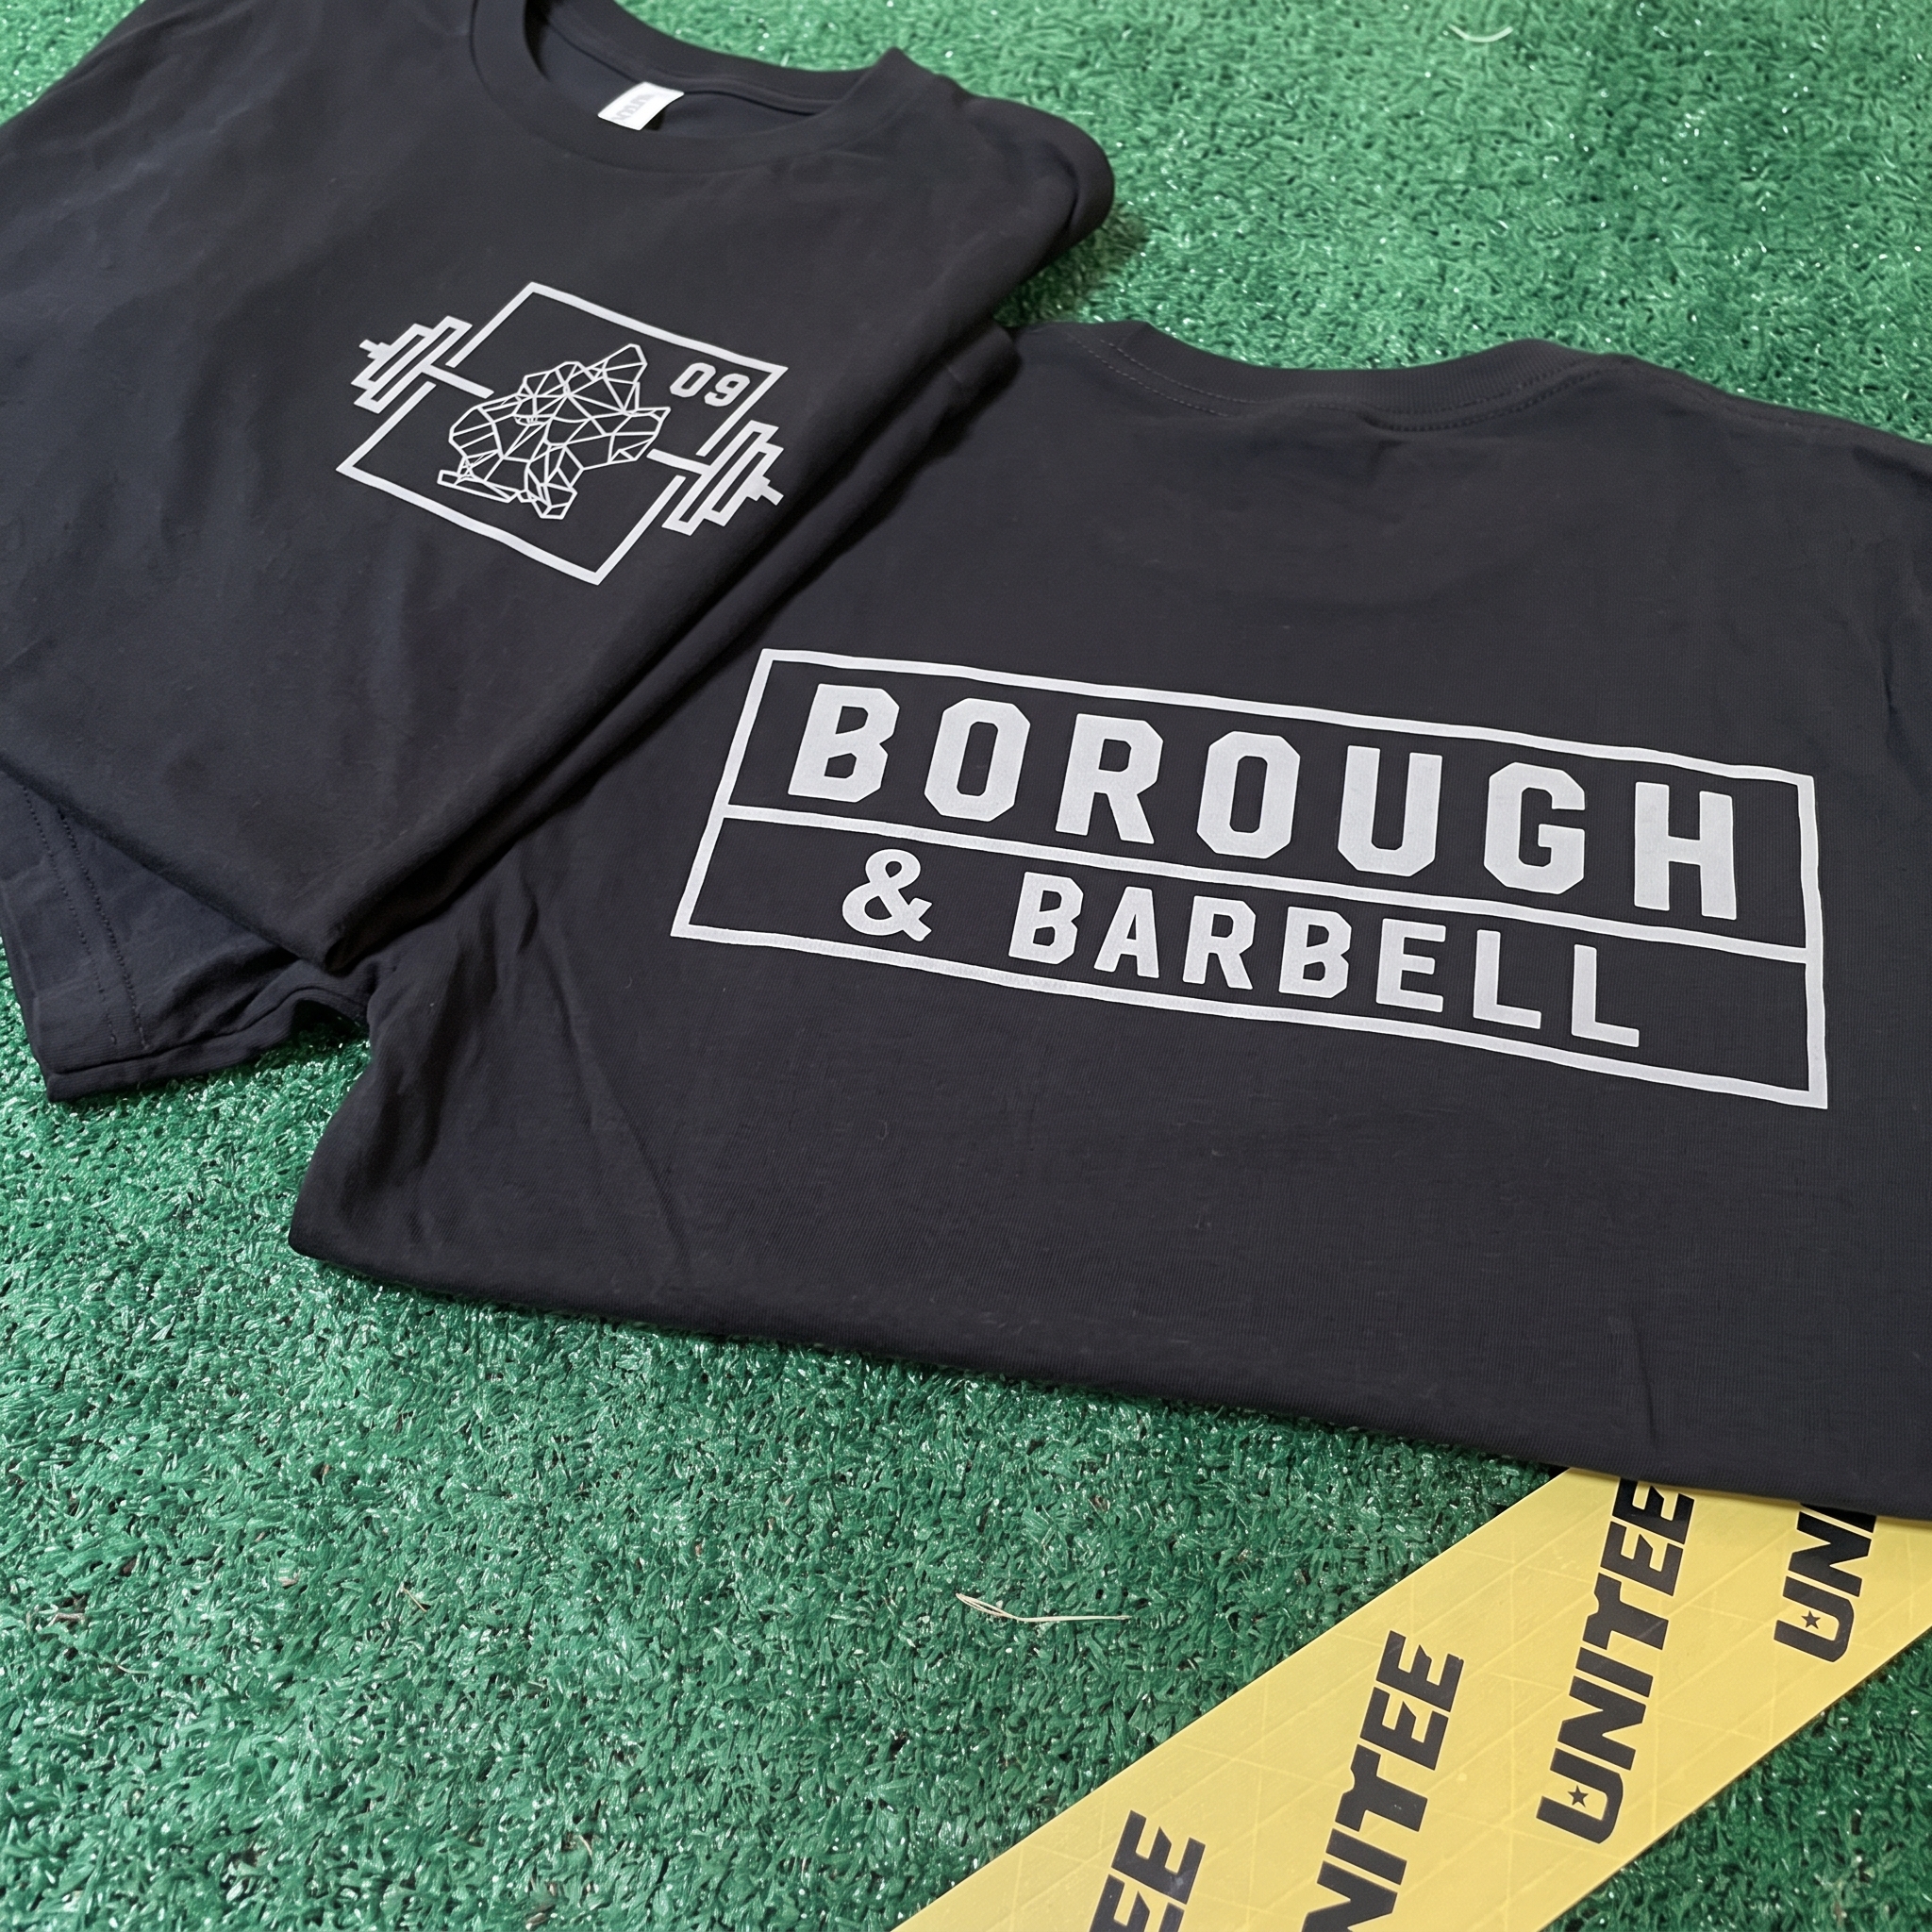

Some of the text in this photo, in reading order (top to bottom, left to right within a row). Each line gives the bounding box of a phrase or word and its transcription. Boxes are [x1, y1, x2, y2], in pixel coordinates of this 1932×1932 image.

[670, 362, 751, 408] 09
[788, 684, 1737, 920] BOROUGH
[842, 849, 1639, 1047] & BARBELL
[1537, 1476, 1694, 1843] UNITEE
